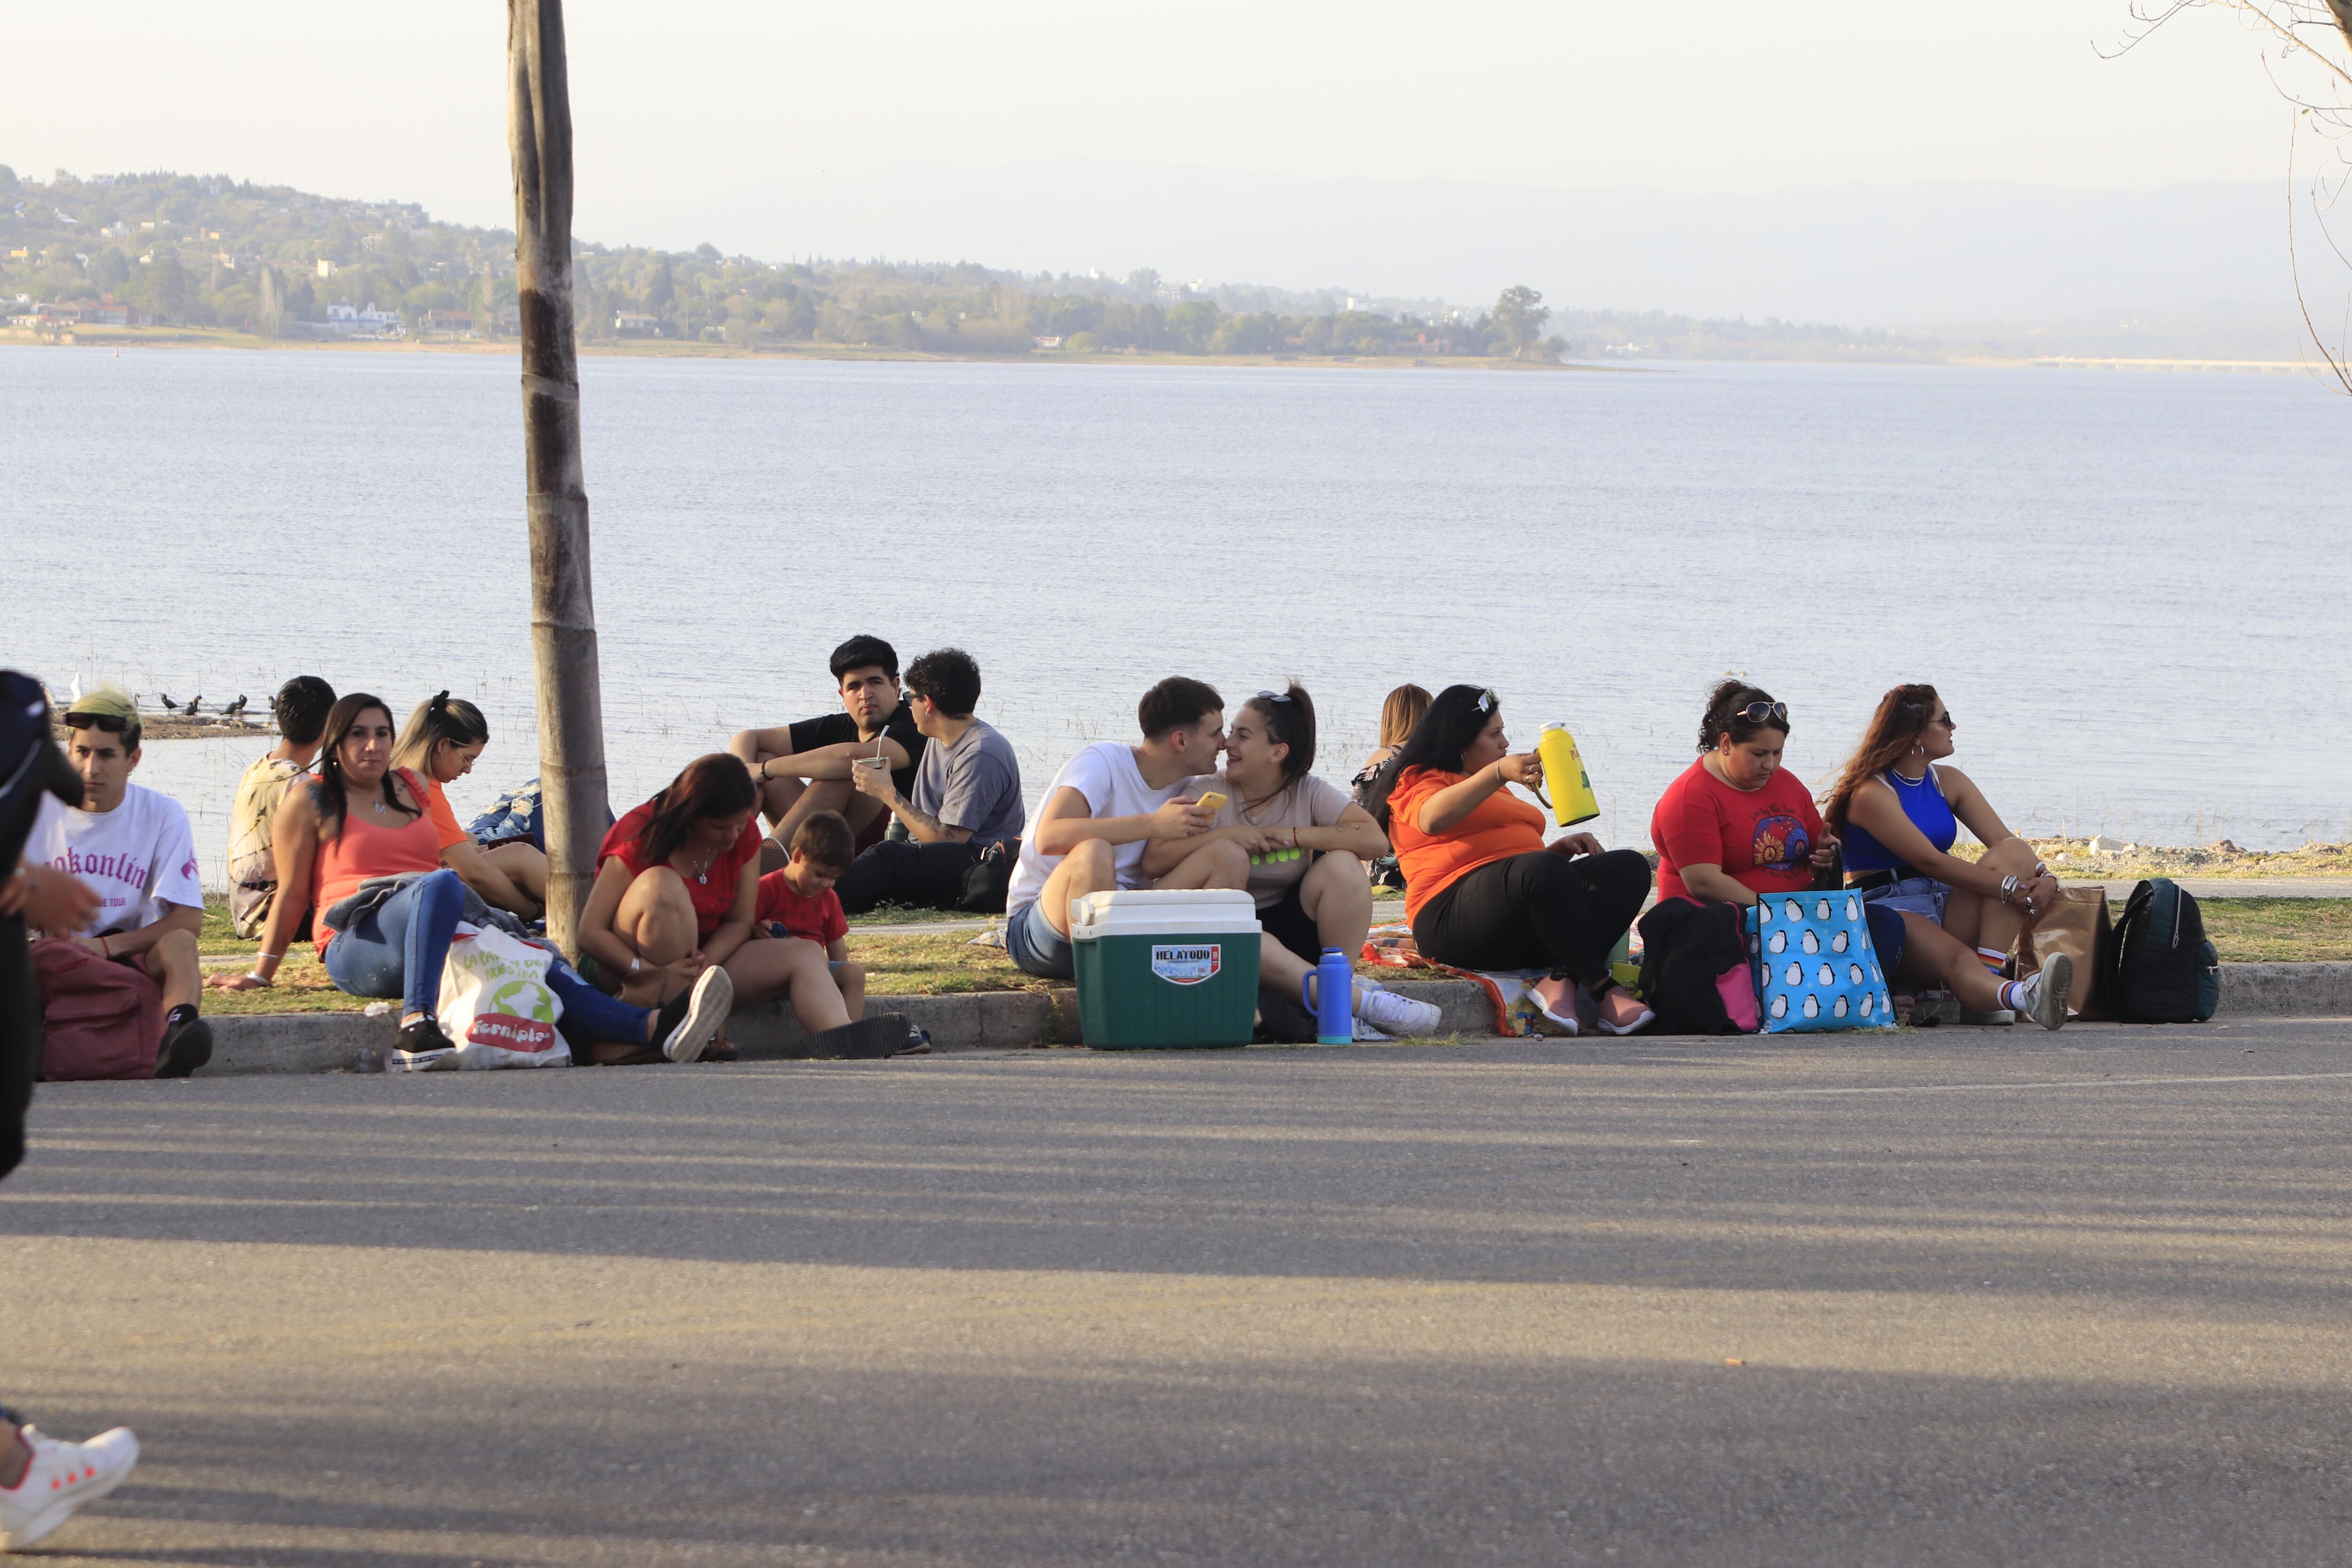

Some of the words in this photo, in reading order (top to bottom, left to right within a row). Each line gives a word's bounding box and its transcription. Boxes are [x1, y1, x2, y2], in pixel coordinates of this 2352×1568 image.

[110, 897, 127, 906] TOUR
[1156, 948, 1210, 960] HELATODO
[463, 954, 477, 969] LA
